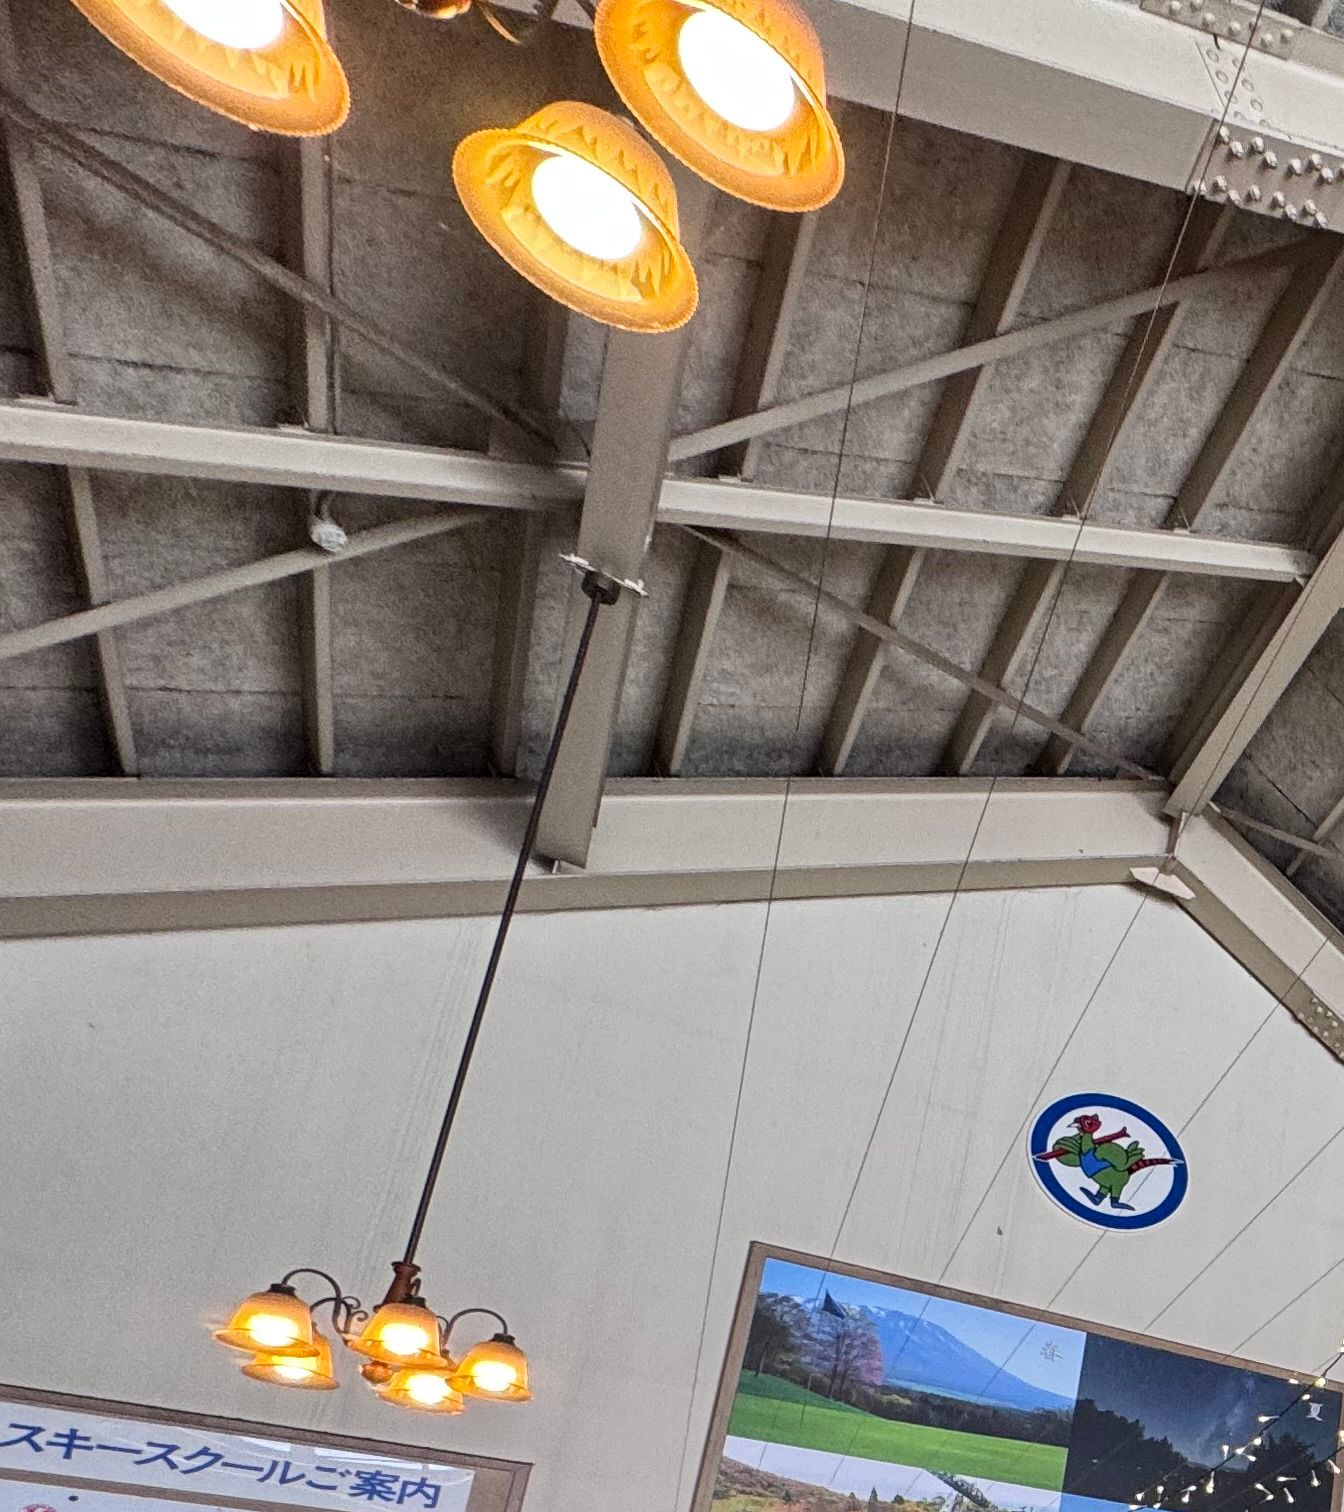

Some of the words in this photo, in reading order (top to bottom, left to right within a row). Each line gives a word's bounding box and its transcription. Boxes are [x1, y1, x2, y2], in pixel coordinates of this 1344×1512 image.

[0, 1422, 442, 1509] スキースクールご案内
